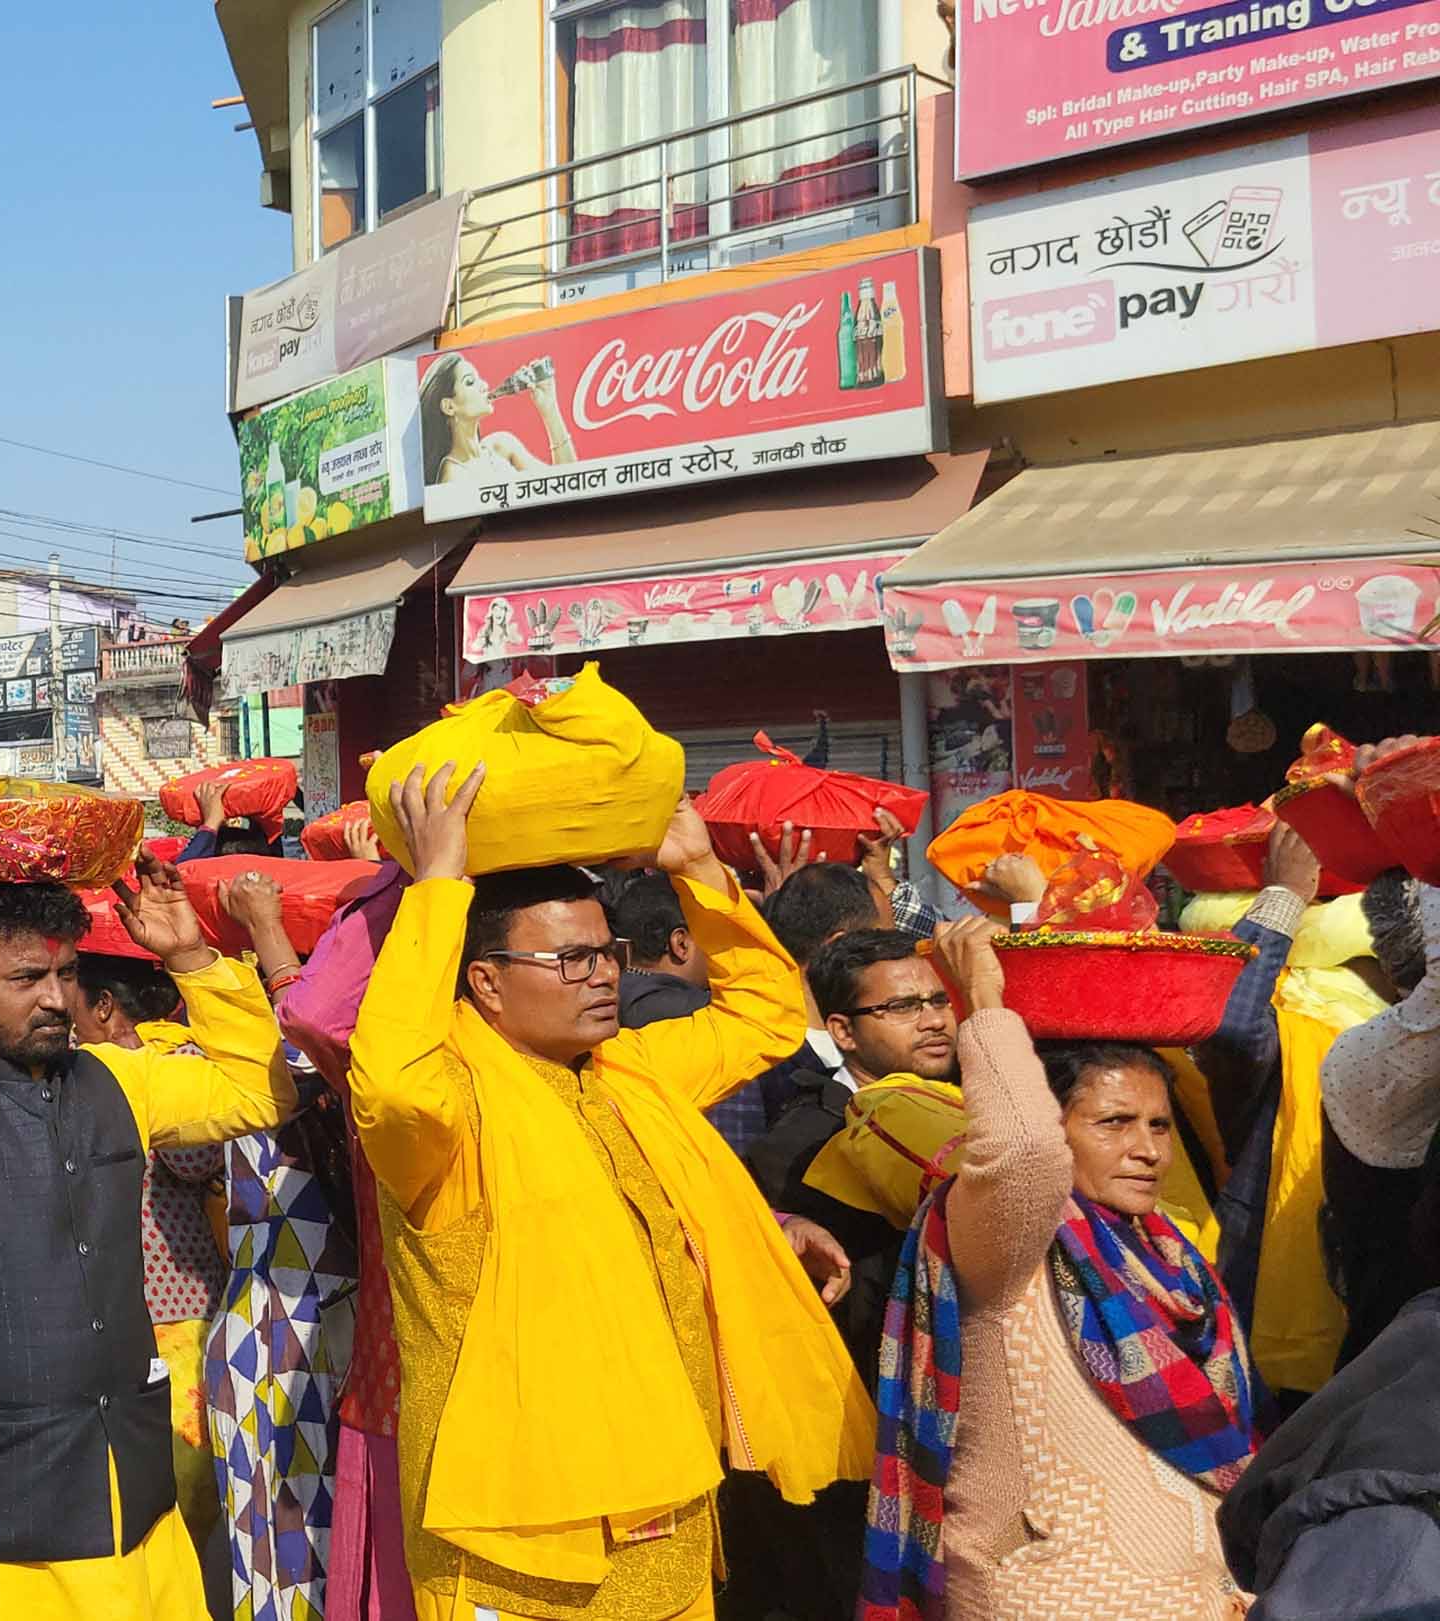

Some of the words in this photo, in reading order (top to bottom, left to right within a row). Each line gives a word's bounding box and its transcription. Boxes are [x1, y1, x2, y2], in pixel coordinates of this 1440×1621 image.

[1118, 31, 1149, 62] &
[1160, 0, 1310, 51] Traning
[1025, 106, 1057, 126] Spl:
[1062, 91, 1112, 117] Bridal
[1250, 47, 1336, 76] Make-up,
[1340, 30, 1400, 55] Water
[1065, 122, 1088, 141] All
[1092, 113, 1135, 137] Type
[1139, 105, 1177, 125] Hair
[1181, 89, 1254, 115] Cutting,
[1259, 79, 1300, 99] Hair
[1305, 67, 1349, 90] SPA,
[1354, 57, 1397, 80] Hair
[1339, 176, 1412, 226] न्यू
[987, 234, 1080, 276] नगद
[1095, 205, 1172, 256] छोडौं
[559, 285, 586, 301] ACP
[1119, 281, 1205, 329] pay
[279, 336, 301, 362] pay
[572, 297, 824, 430] Coca-Cola
[478, 481, 510, 509] न्यू
[515, 467, 606, 501] जयसवाल
[615, 457, 672, 487] माधव
[752, 440, 805, 466] जानकी
[811, 435, 848, 457] चौक
[644, 582, 696, 609] Vadilal
[1151, 579, 1316, 640] Vadilal
